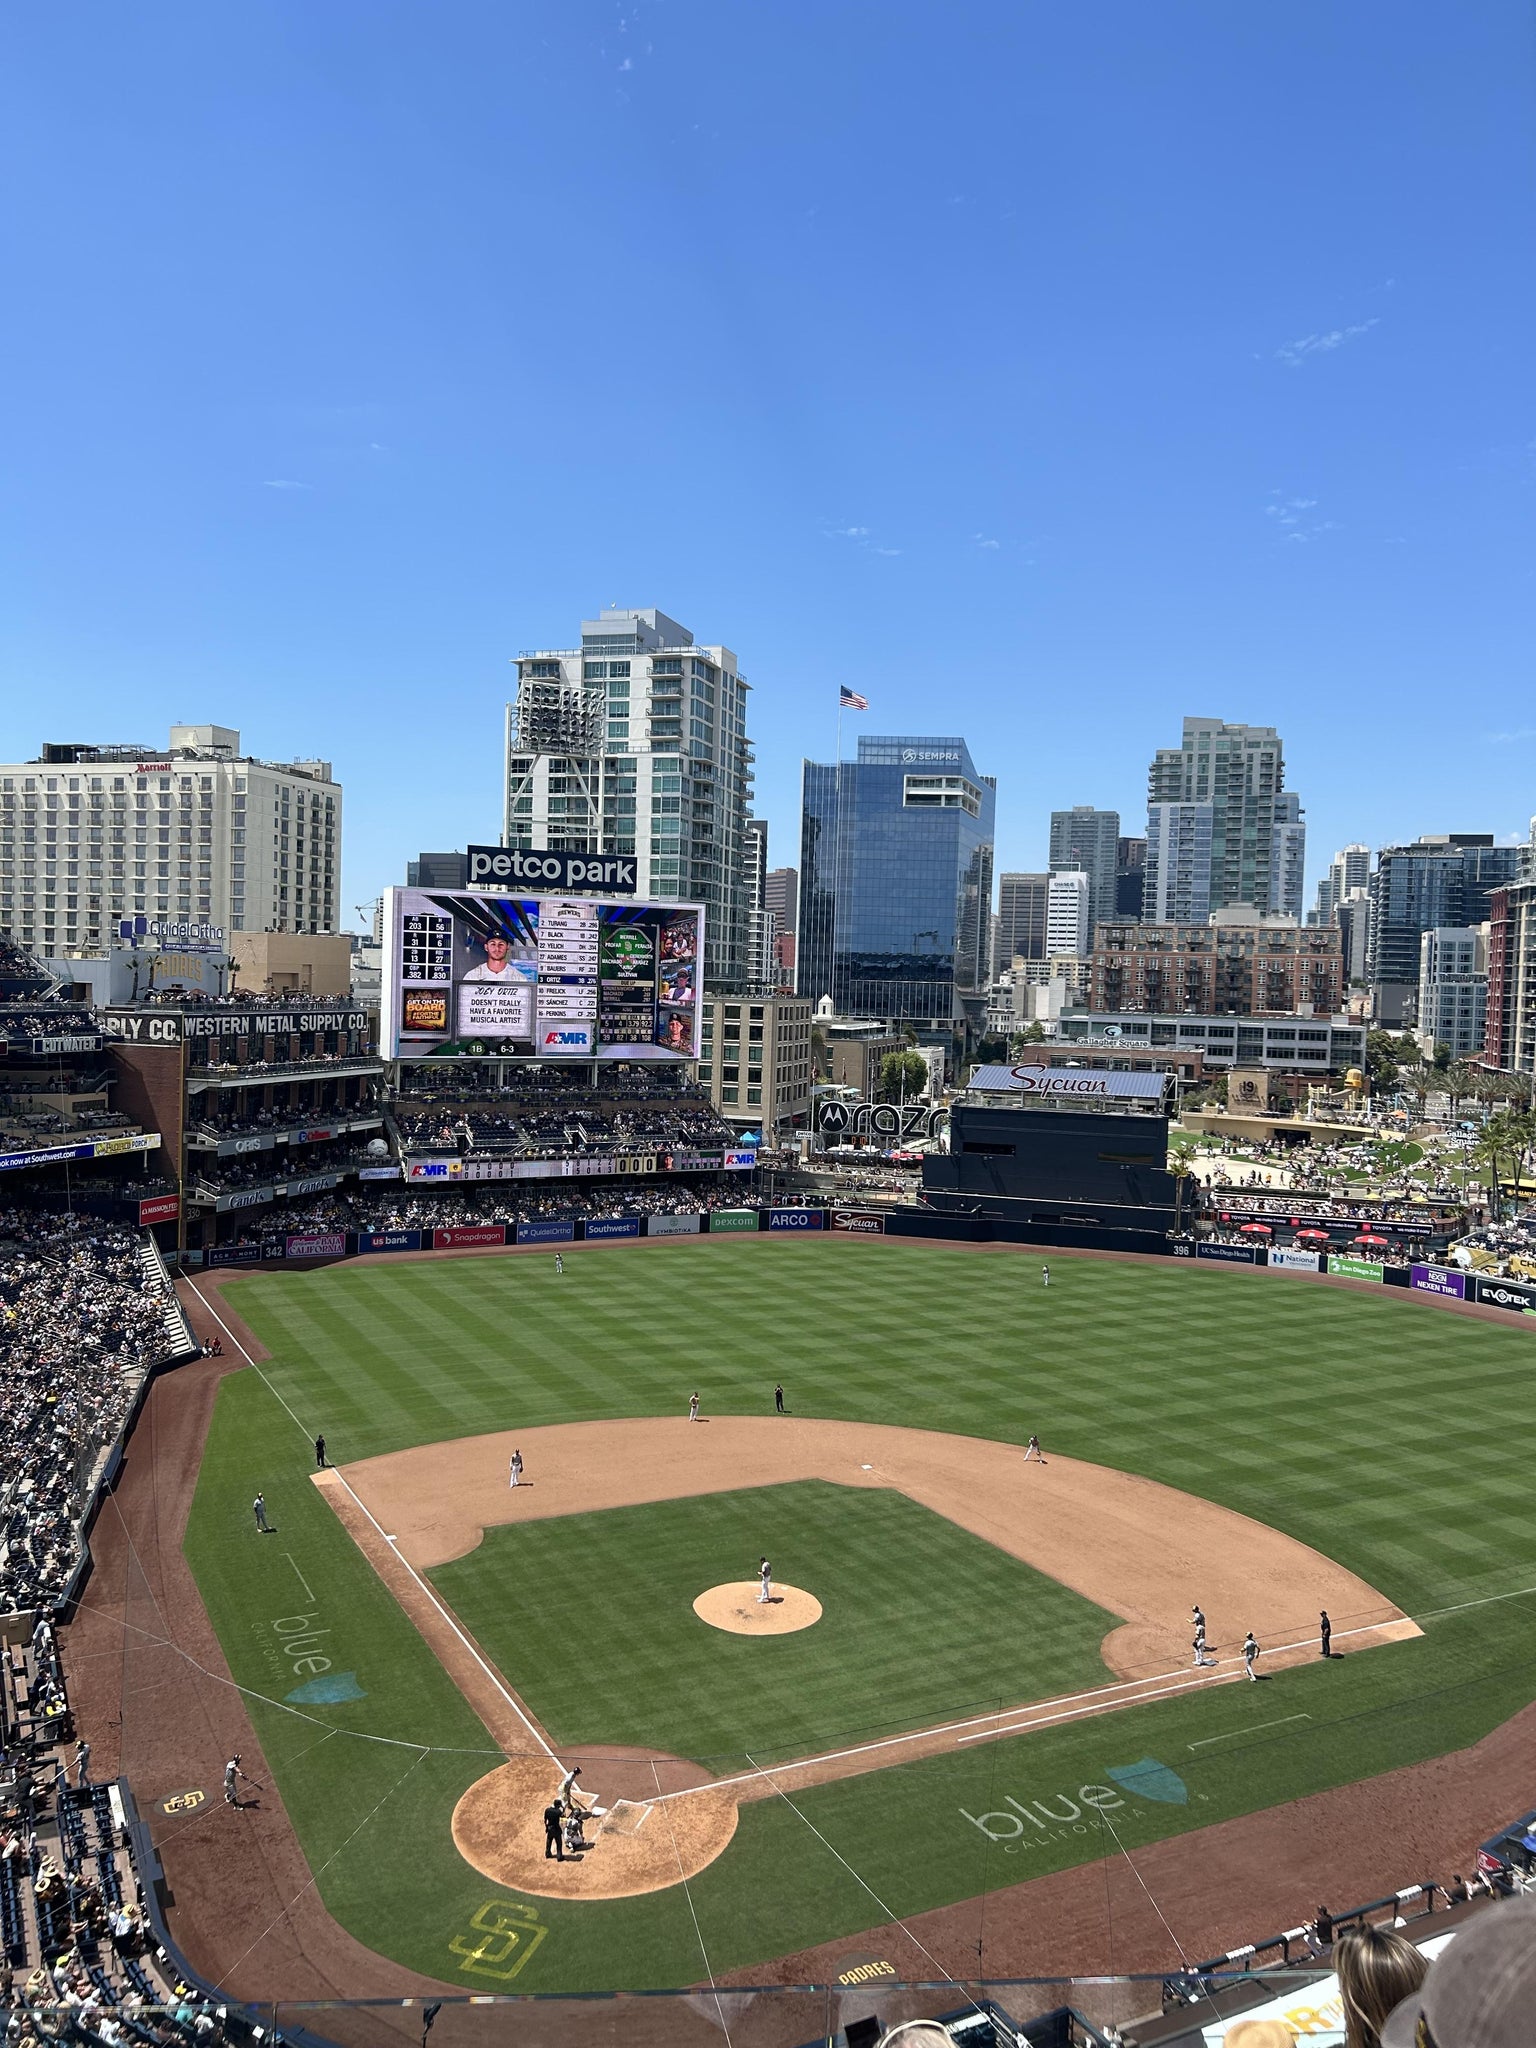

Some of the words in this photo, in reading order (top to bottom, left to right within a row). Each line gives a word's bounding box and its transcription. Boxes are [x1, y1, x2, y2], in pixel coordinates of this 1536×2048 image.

[919, 752, 959, 761] SEMPRA
[135, 763, 171, 773] Marriott
[471, 850, 562, 881] petco
[566, 859, 634, 887] park
[150, 920, 223, 939] QuidelOrtho
[409, 922, 422, 930] 203
[153, 954, 202, 982] PADRES
[475, 987, 494, 996] JOEY
[497, 987, 518, 996] ORTIZ
[149, 1019, 180, 1041] CO.
[184, 1016, 249, 1036] WESTERN
[256, 1015, 297, 1033] METAL
[300, 1014, 345, 1032] SUPPLY
[348, 1014, 367, 1030] CO.
[545, 1032, 587, 1044] AMR
[1077, 1037, 1117, 1046] Gallagher
[1119, 1038, 1148, 1048] Square
[42, 1038, 96, 1052] CUTWATER
[1008, 1062, 1110, 1099] Sycuan
[1243, 1081, 1254, 1092] 19
[852, 1102, 949, 1137] razr
[10, 1158, 24, 1166] now
[31, 1151, 76, 1163] Southwest.com
[725, 1153, 755, 1164] AMR
[411, 1165, 448, 1176] AMR
[620, 1159, 626, 1172] 0
[633, 1159, 639, 1171] 0
[647, 1159, 653, 1171] 0
[297, 1176, 329, 1194] Canel's
[228, 1190, 265, 1208] Canel's
[147, 1205, 168, 1214] MISSION
[186, 1206, 200, 1219] 336
[771, 1215, 808, 1225] ARCO
[834, 1213, 879, 1230] Sycuan
[530, 1227, 572, 1237] QuidelOrtho
[588, 1224, 630, 1234] Southwest
[321, 1236, 342, 1245] BAJA
[385, 1236, 408, 1245] bank
[454, 1232, 501, 1242] Snapdragon
[266, 1246, 283, 1258] 342
[289, 1243, 344, 1255] CALIFORNIA
[1173, 1245, 1189, 1256] 396
[1220, 1249, 1233, 1257] Diego
[1286, 1255, 1316, 1264] National
[1352, 1266, 1368, 1275] Diego
[1369, 1269, 1381, 1277] Zoo
[1417, 1280, 1440, 1293] NEXEN
[1441, 1285, 1458, 1296] TIRE
[1482, 1288, 1530, 1307] EVOTEK
[271, 1612, 332, 1675] blue
[958, 1784, 1126, 1842] blue
[1003, 1807, 1147, 1854] CALIFORNIA
[838, 1960, 896, 1985] PADRES
